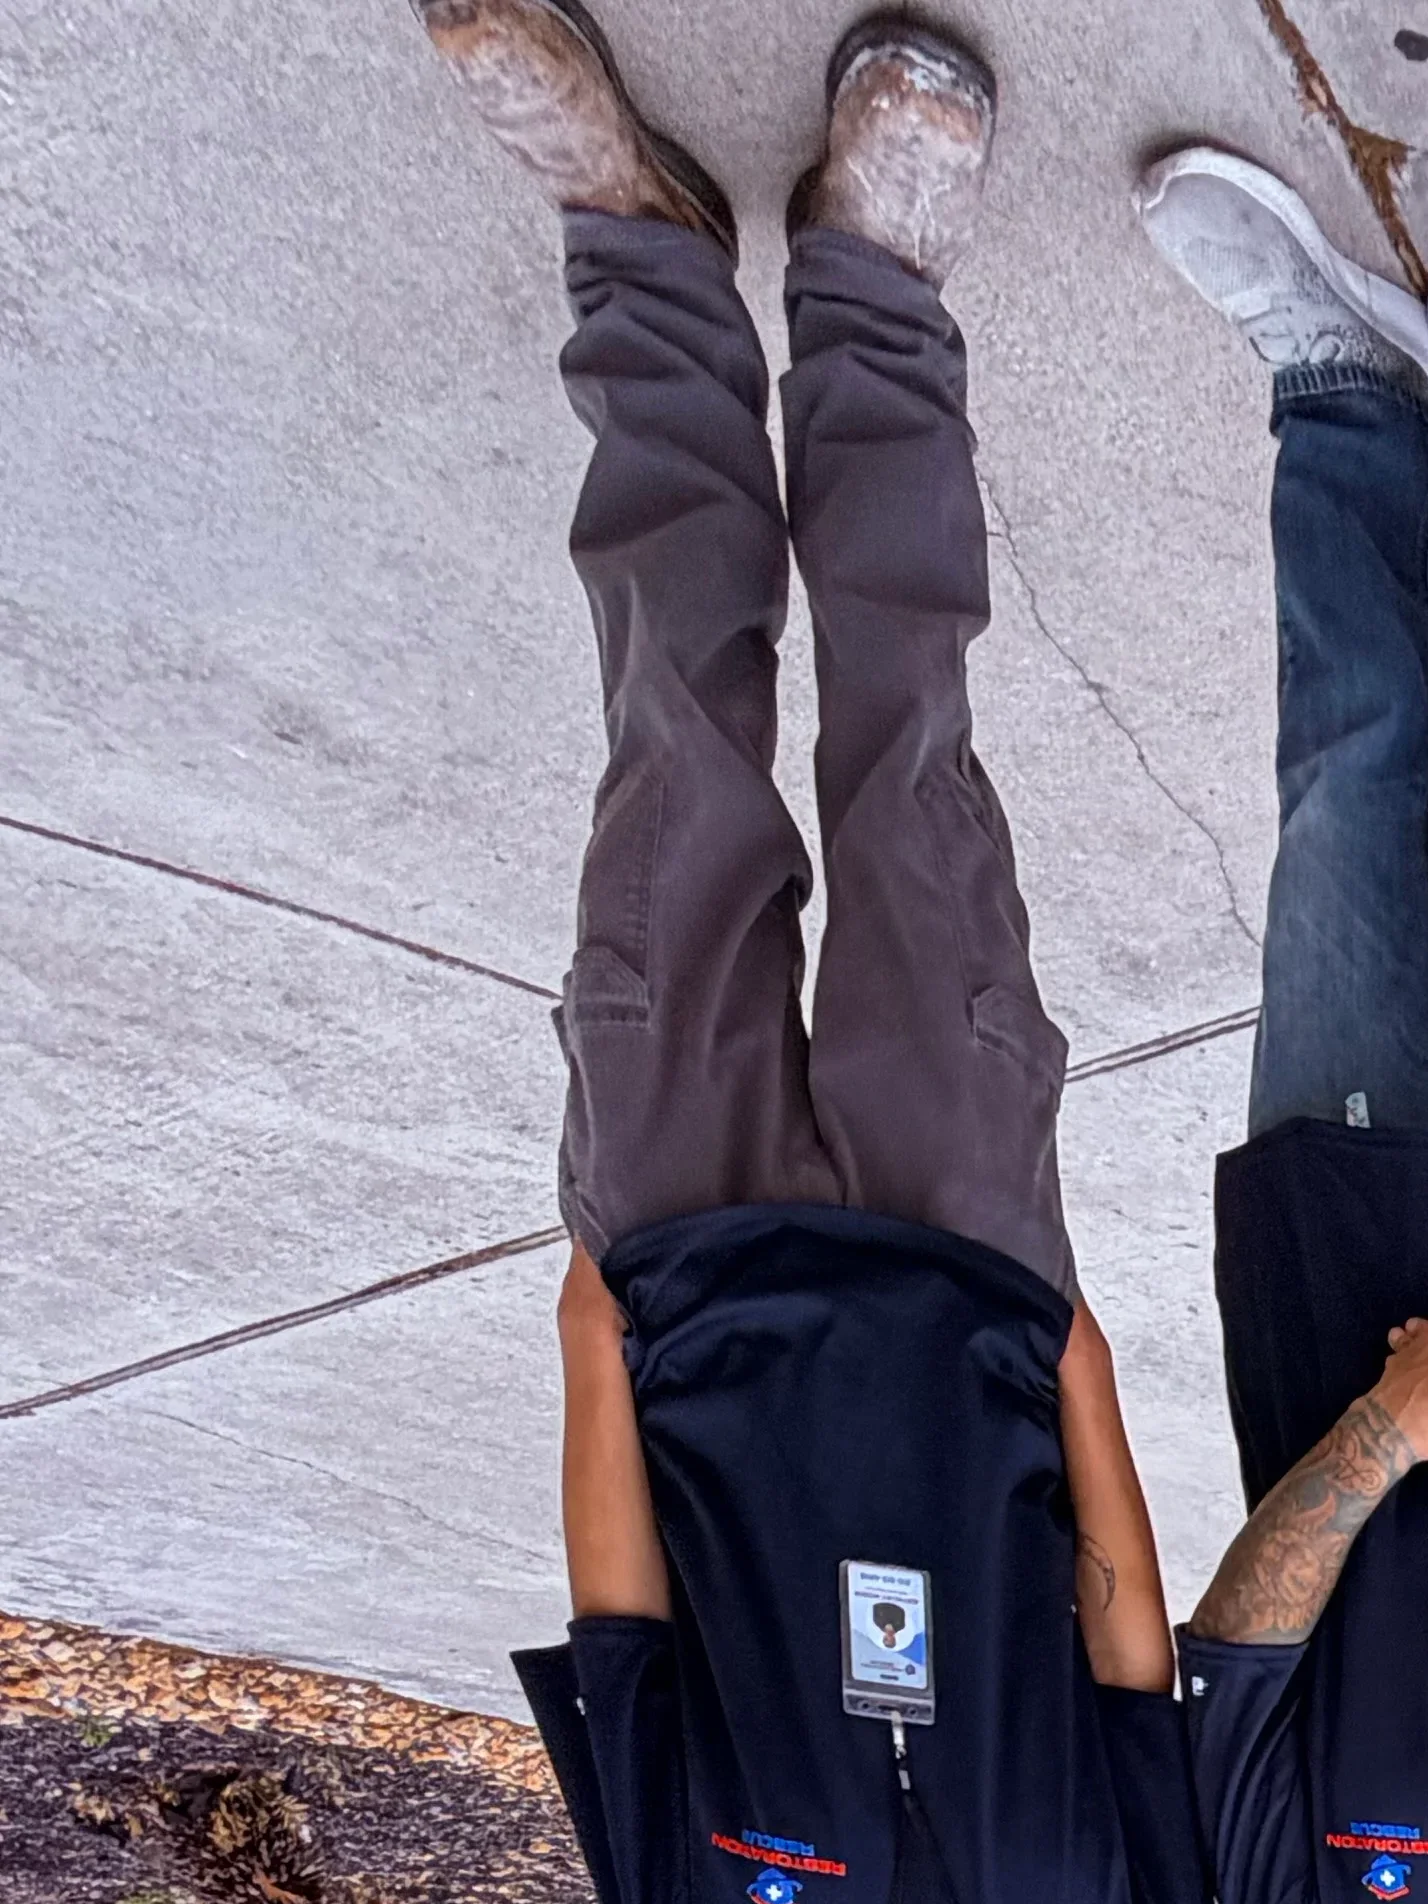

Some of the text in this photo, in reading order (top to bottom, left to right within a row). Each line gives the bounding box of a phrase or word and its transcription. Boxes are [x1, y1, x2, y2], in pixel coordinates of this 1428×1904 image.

[741, 1828, 815, 1857] RESCUE
[1349, 1821, 1421, 1840] RESCUE
[710, 1831, 847, 1877] RESTORATION
